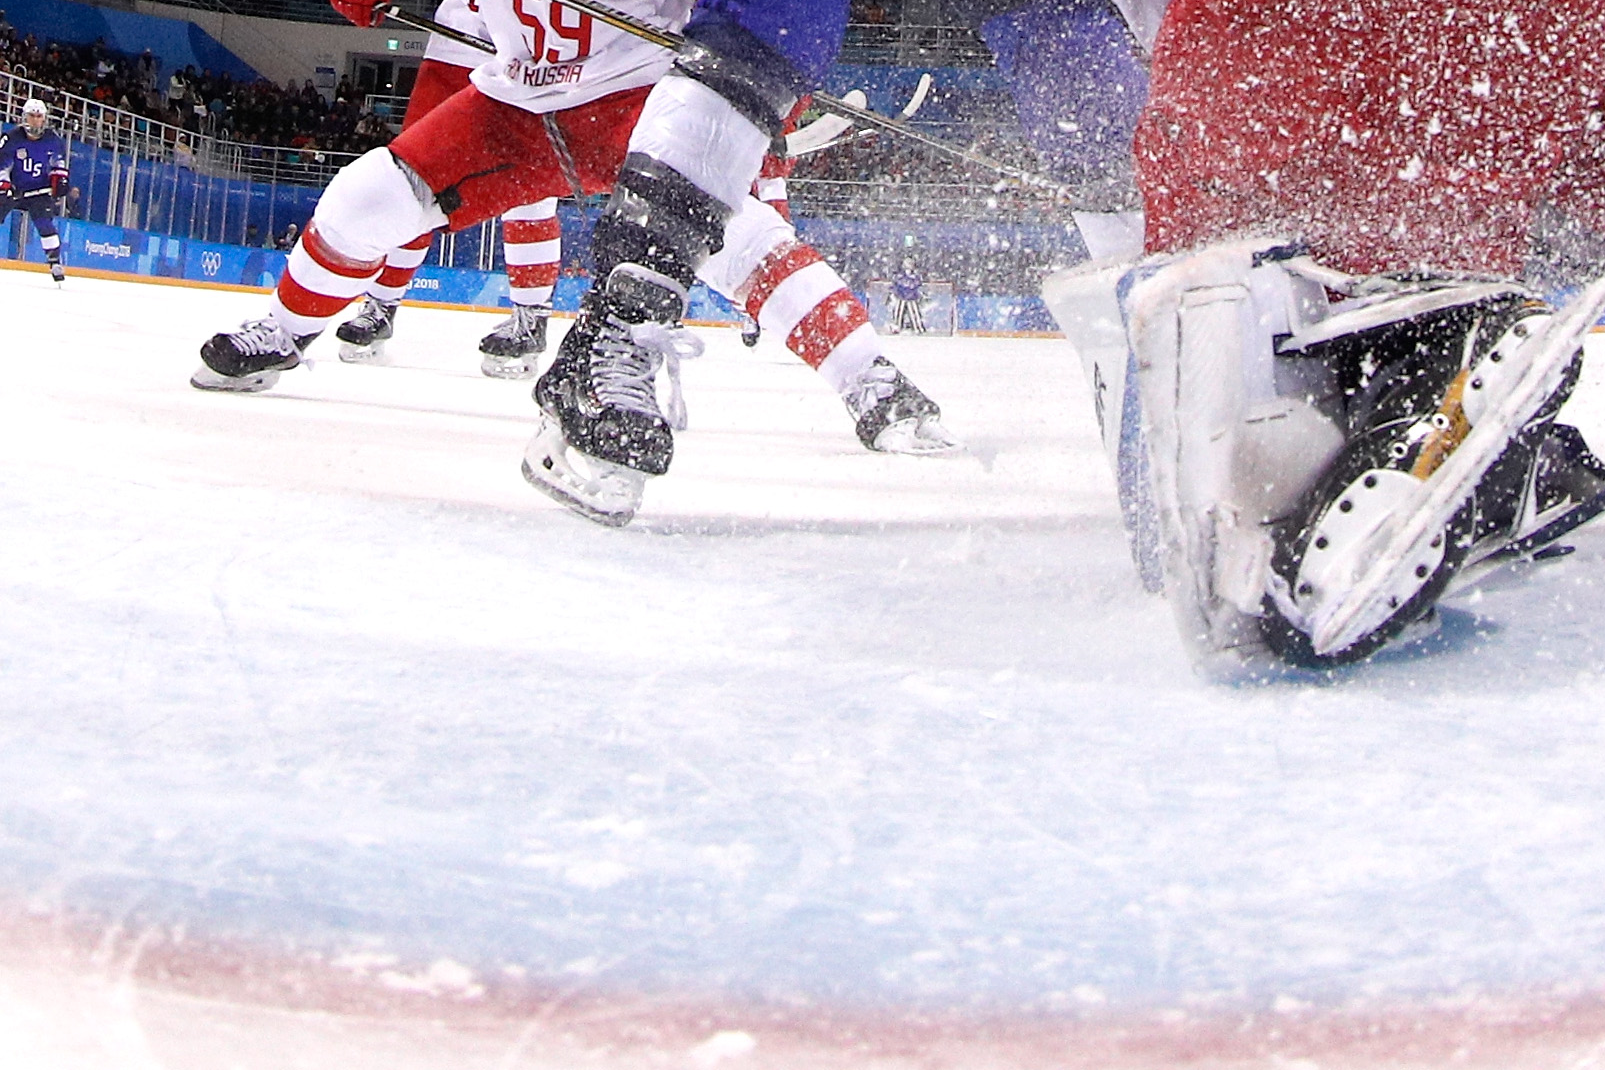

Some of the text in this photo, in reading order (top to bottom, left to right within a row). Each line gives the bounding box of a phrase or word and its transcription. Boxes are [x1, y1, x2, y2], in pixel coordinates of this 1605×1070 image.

[523, 64, 584, 87] RUSSIA
[23, 157, 43, 178] US
[414, 278, 440, 290] 2018
